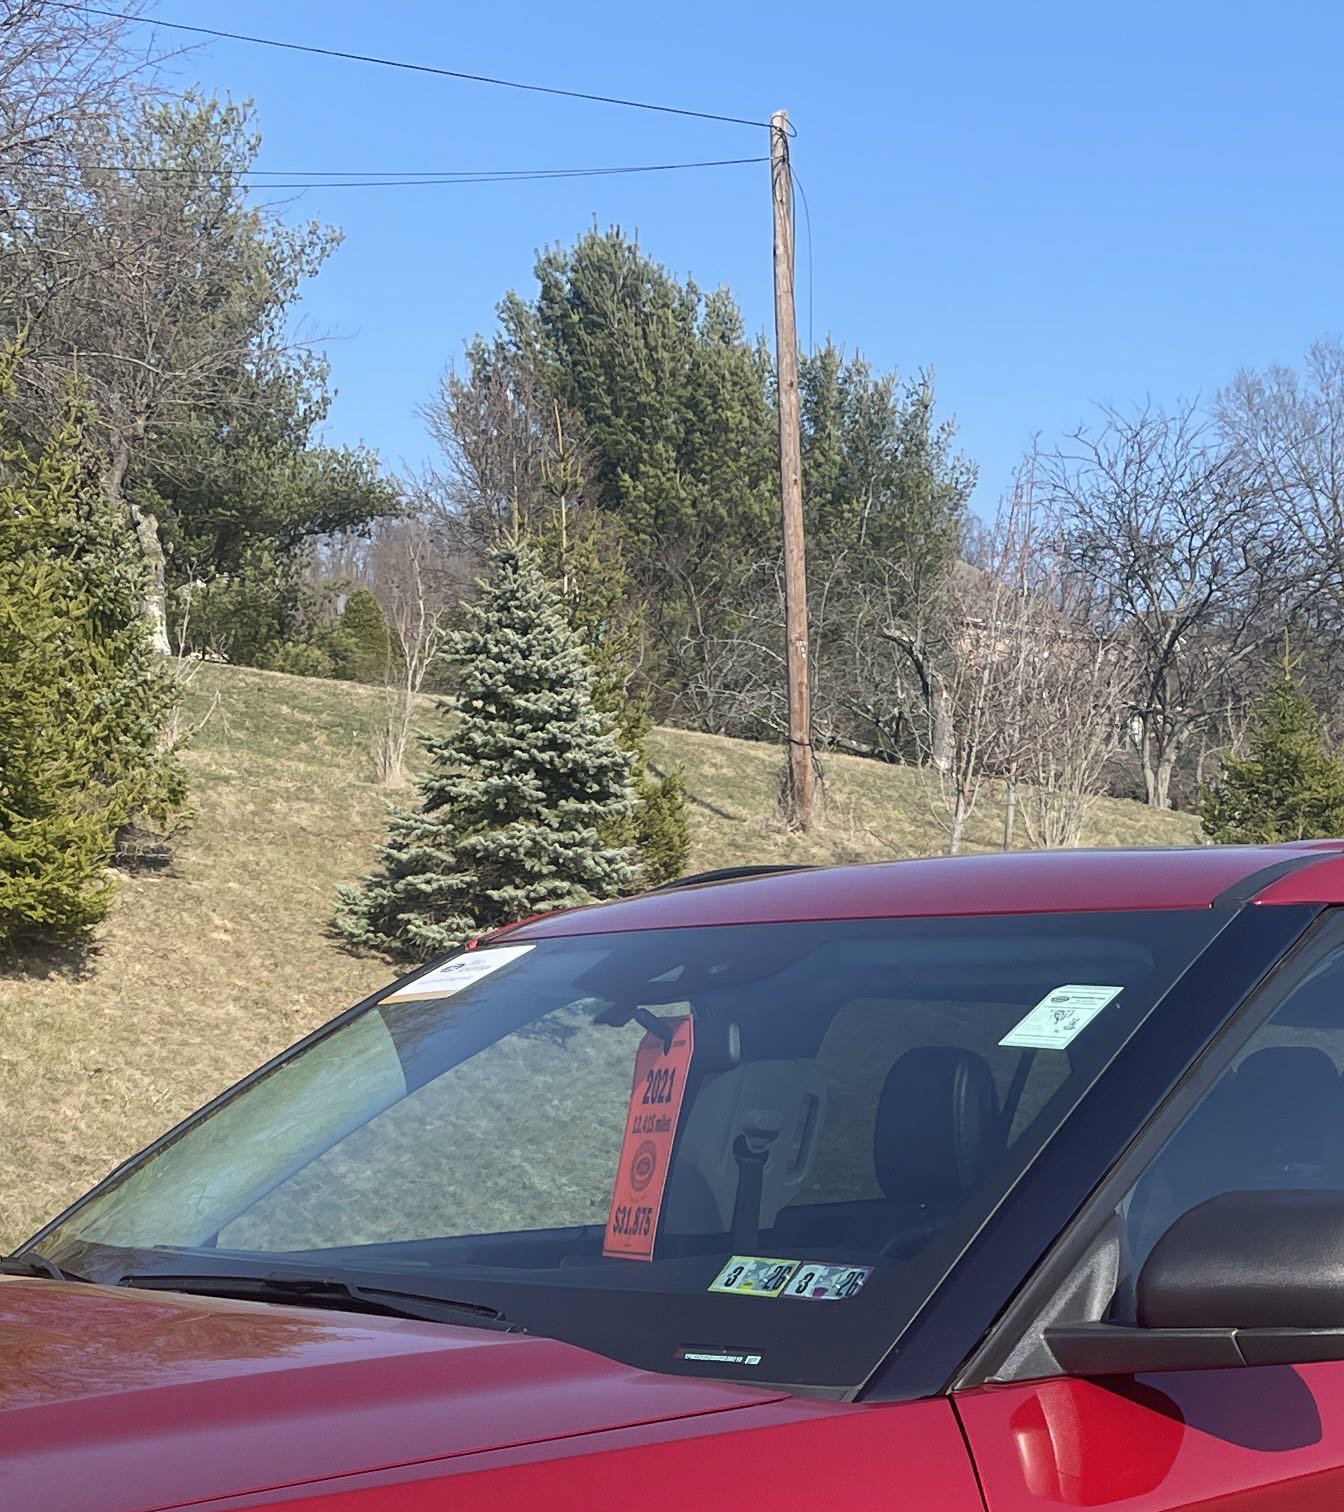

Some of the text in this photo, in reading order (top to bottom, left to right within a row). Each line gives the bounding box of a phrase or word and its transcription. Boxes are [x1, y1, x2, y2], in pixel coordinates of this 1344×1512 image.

[642, 1067, 676, 1105] 2021
[724, 1265, 793, 1291] 3 26
[795, 1271, 866, 1297] 3 26
